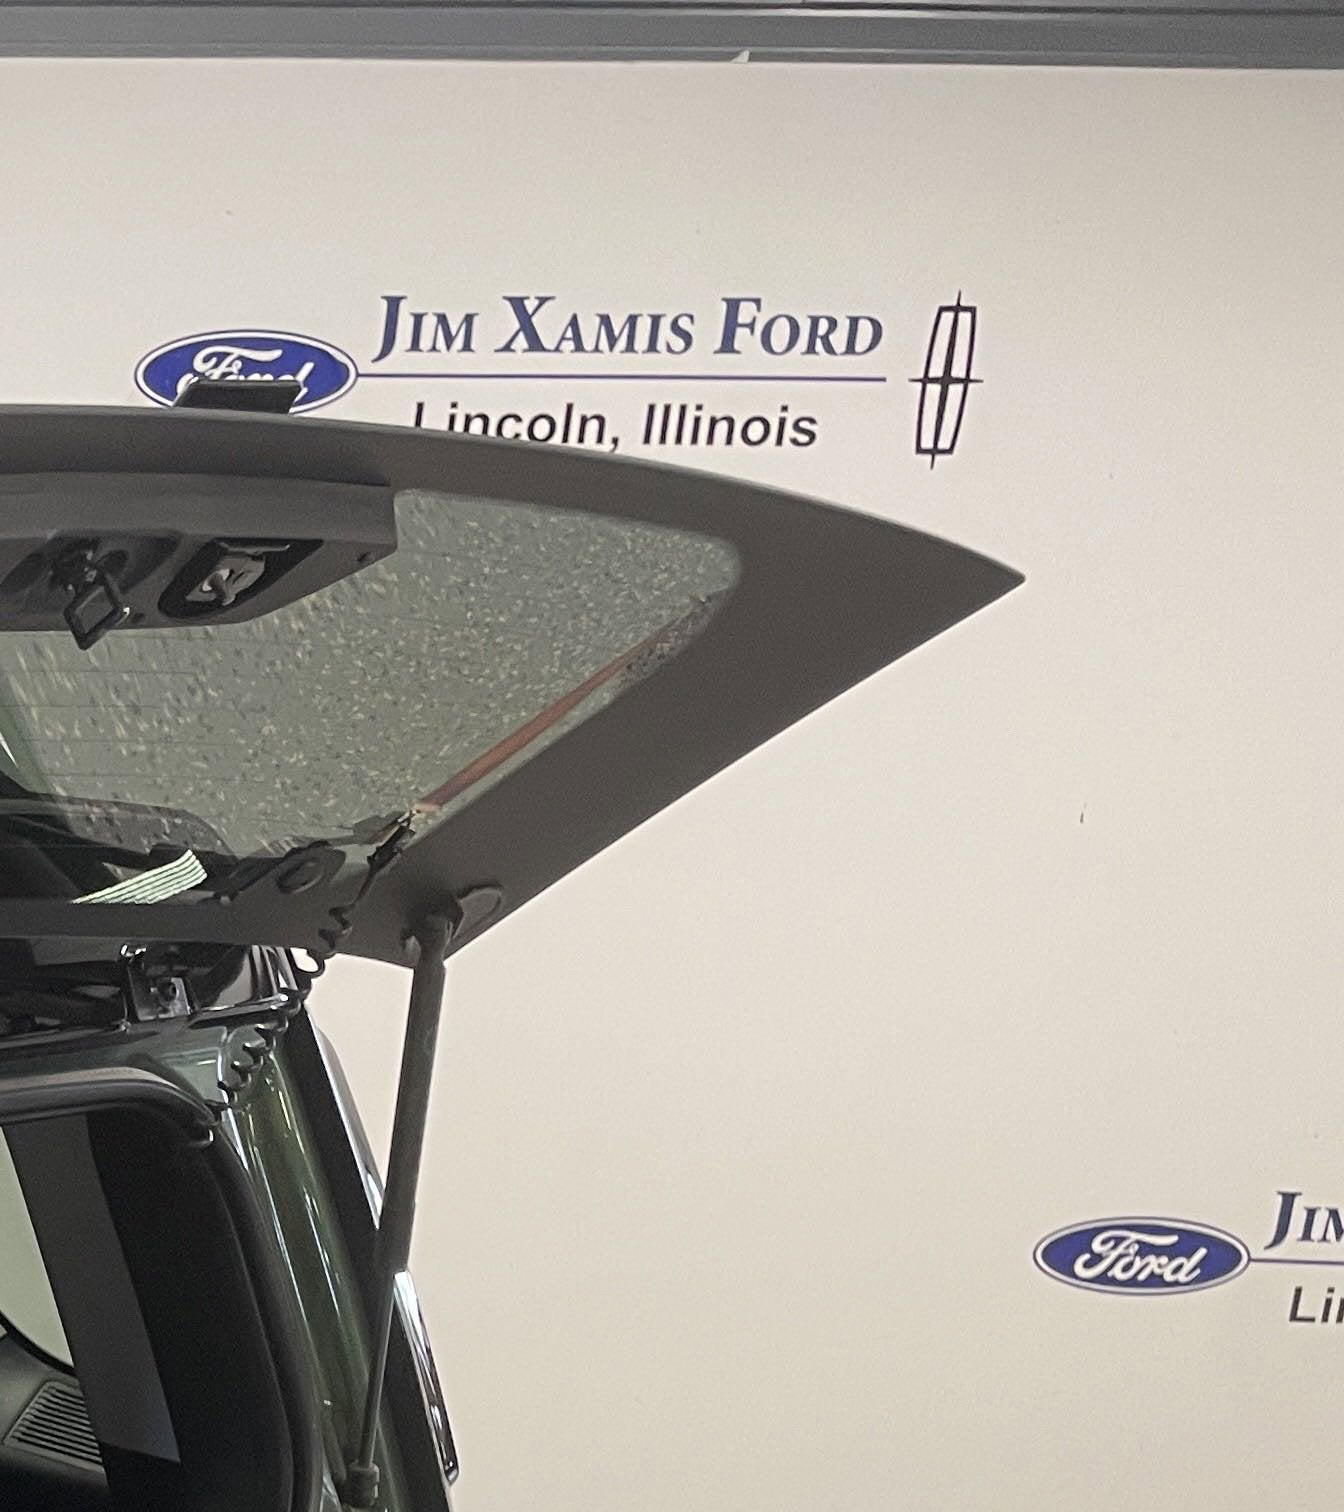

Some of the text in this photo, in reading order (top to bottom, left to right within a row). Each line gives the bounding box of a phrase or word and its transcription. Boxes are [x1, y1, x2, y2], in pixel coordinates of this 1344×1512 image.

[642, 402, 819, 449] Illinois
[1073, 1230, 1208, 1286] Ford
[1288, 1285, 1344, 1324] Li
